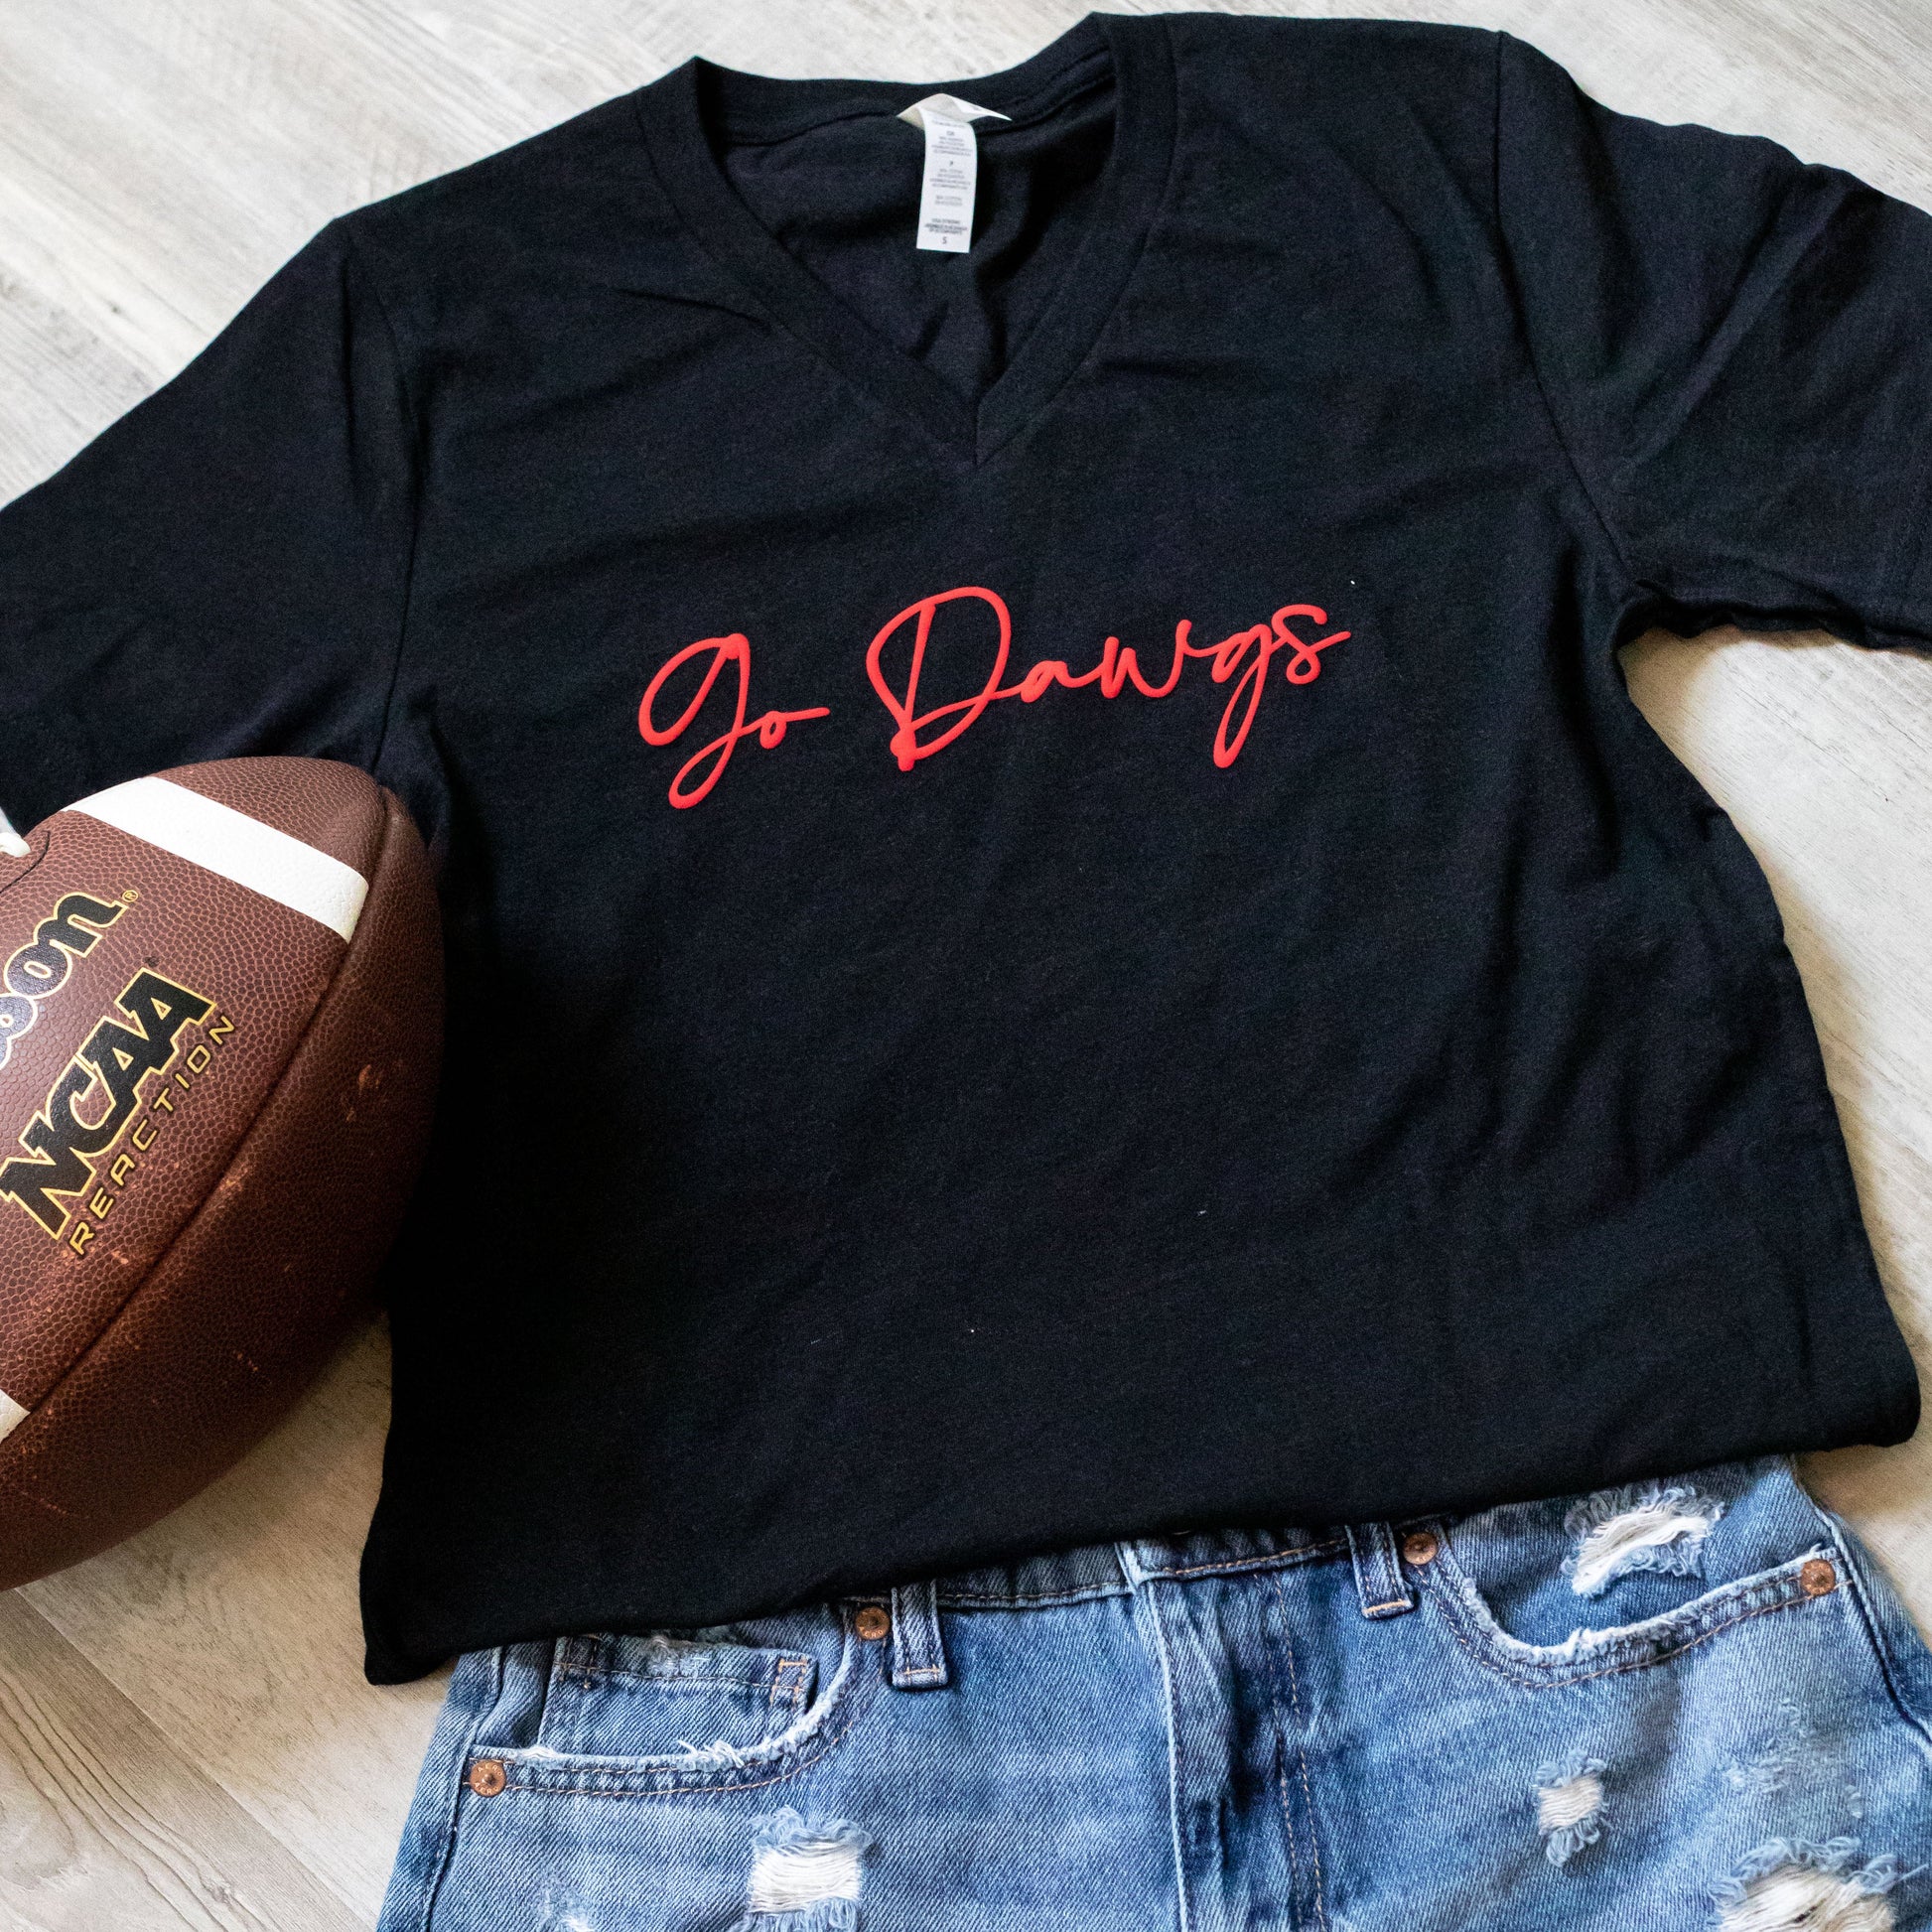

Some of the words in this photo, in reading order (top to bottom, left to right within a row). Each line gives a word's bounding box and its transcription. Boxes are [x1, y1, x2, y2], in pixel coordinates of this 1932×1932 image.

[866, 587, 1350, 771] Dawgs
[0, 967, 217, 1240] NCAA
[69, 1016, 235, 1255] REACTION
